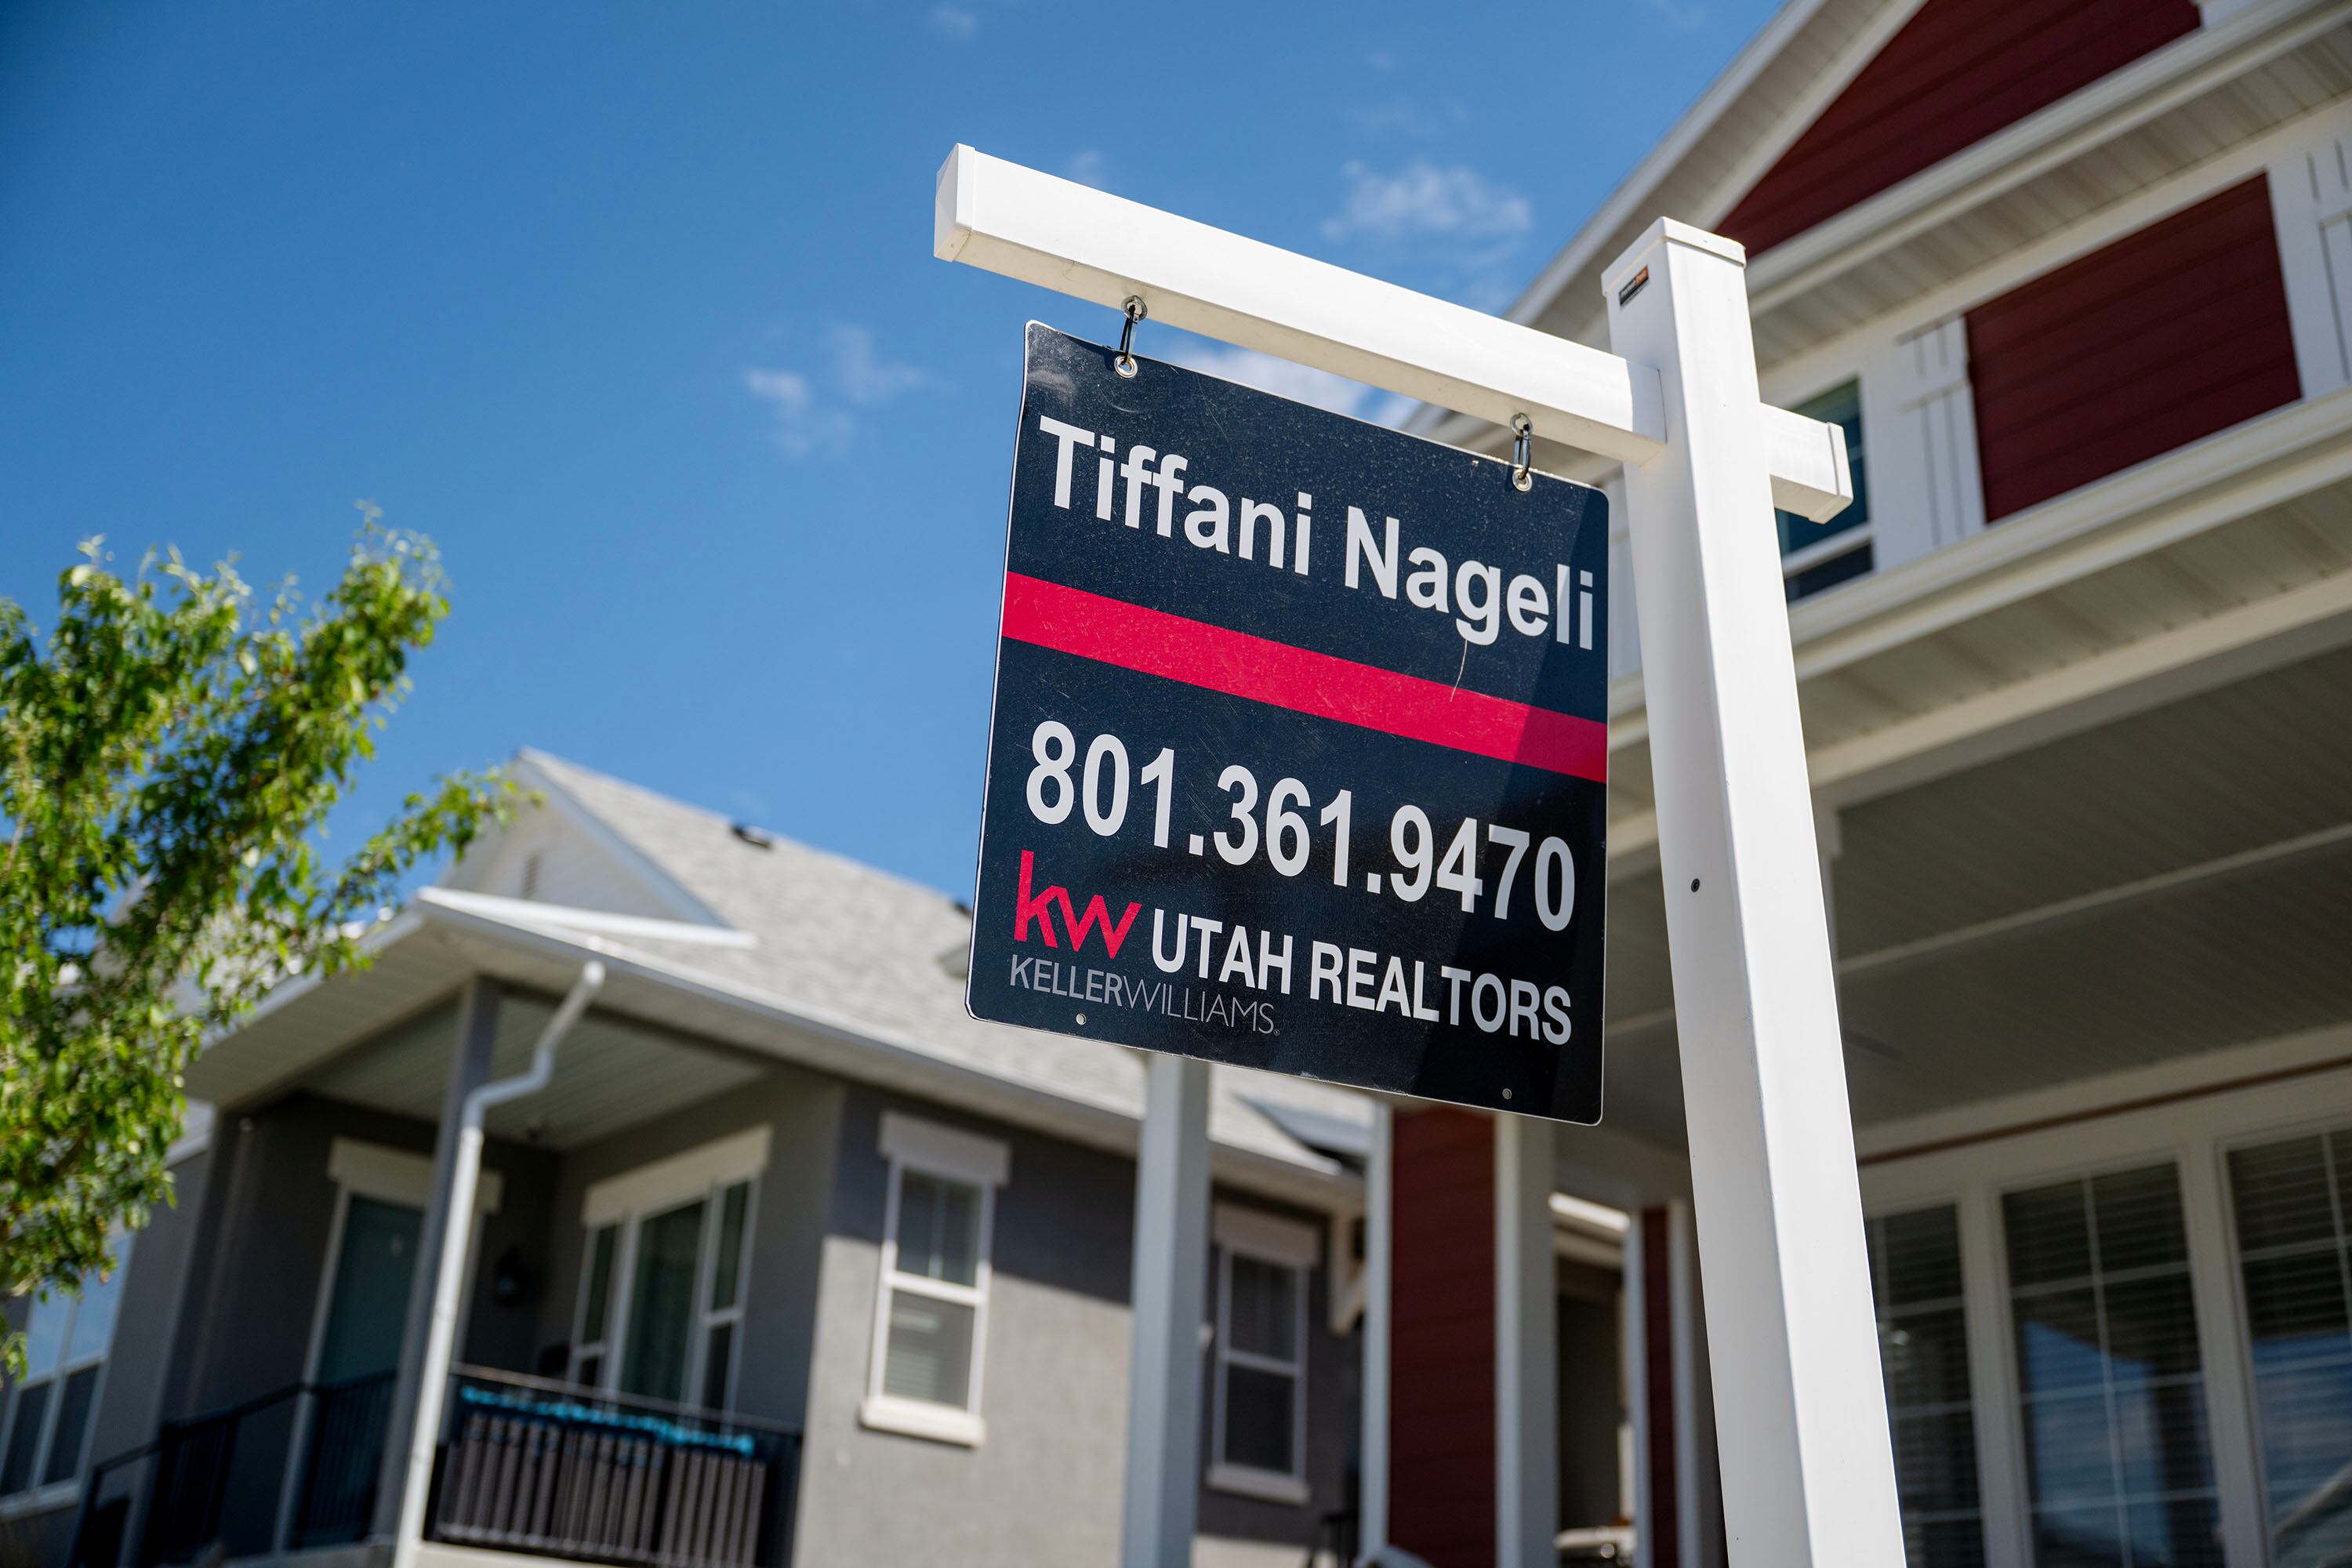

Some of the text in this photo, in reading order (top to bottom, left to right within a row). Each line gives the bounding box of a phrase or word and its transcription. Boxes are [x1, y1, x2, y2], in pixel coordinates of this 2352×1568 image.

[1040, 415, 1594, 651] Tiffani Nageli
[1026, 720, 1575, 931] 801.361.9470
[1014, 850, 1572, 1045] kw UTAH REALTORS
